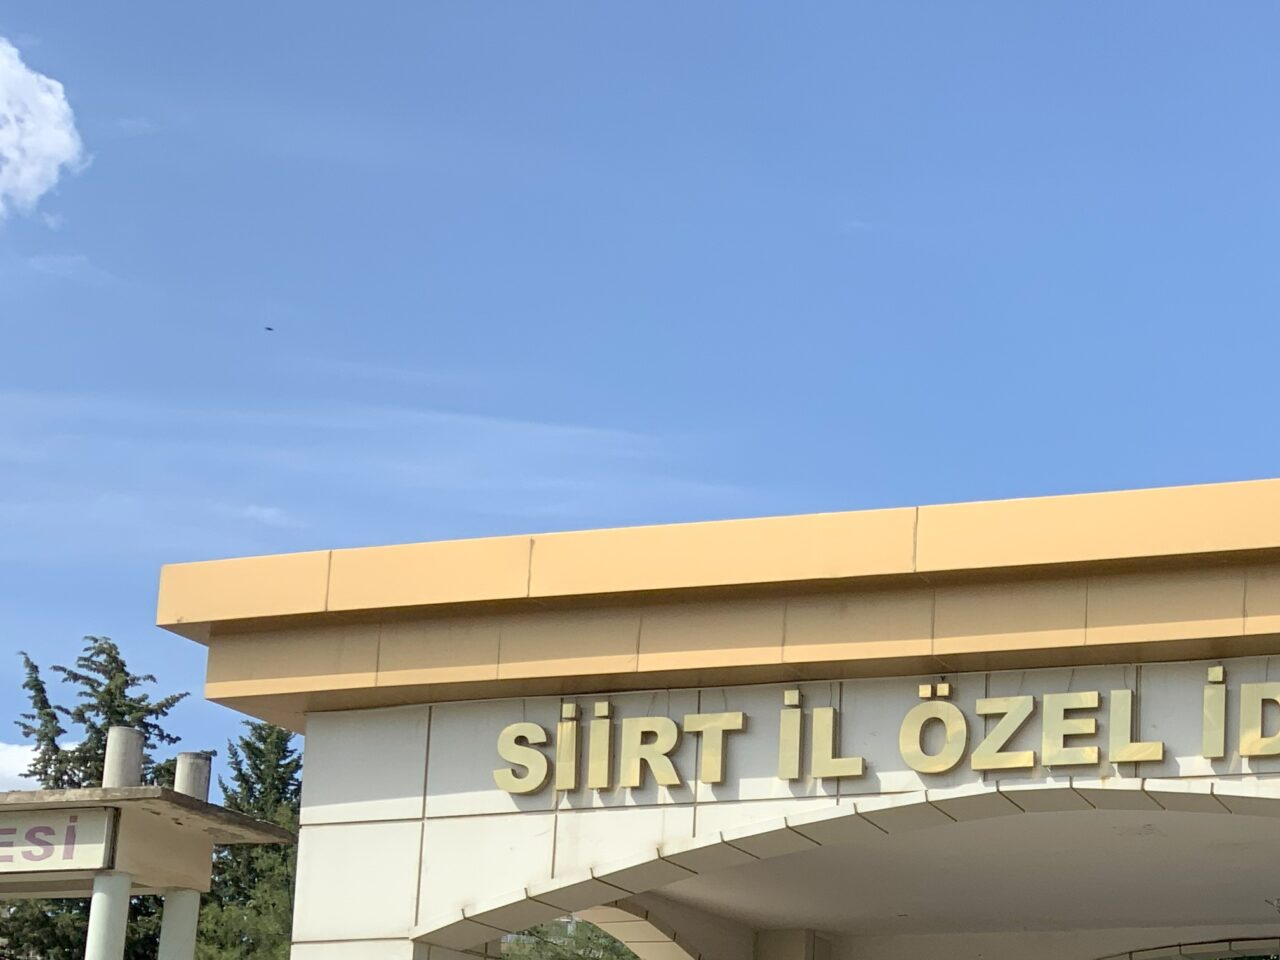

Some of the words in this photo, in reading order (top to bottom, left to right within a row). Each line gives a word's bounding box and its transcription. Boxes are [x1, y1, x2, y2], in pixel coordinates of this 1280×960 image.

[492, 702, 747, 795] SİİRT
[778, 689, 866, 780] İL
[898, 682, 1165, 775] ÖZEL
